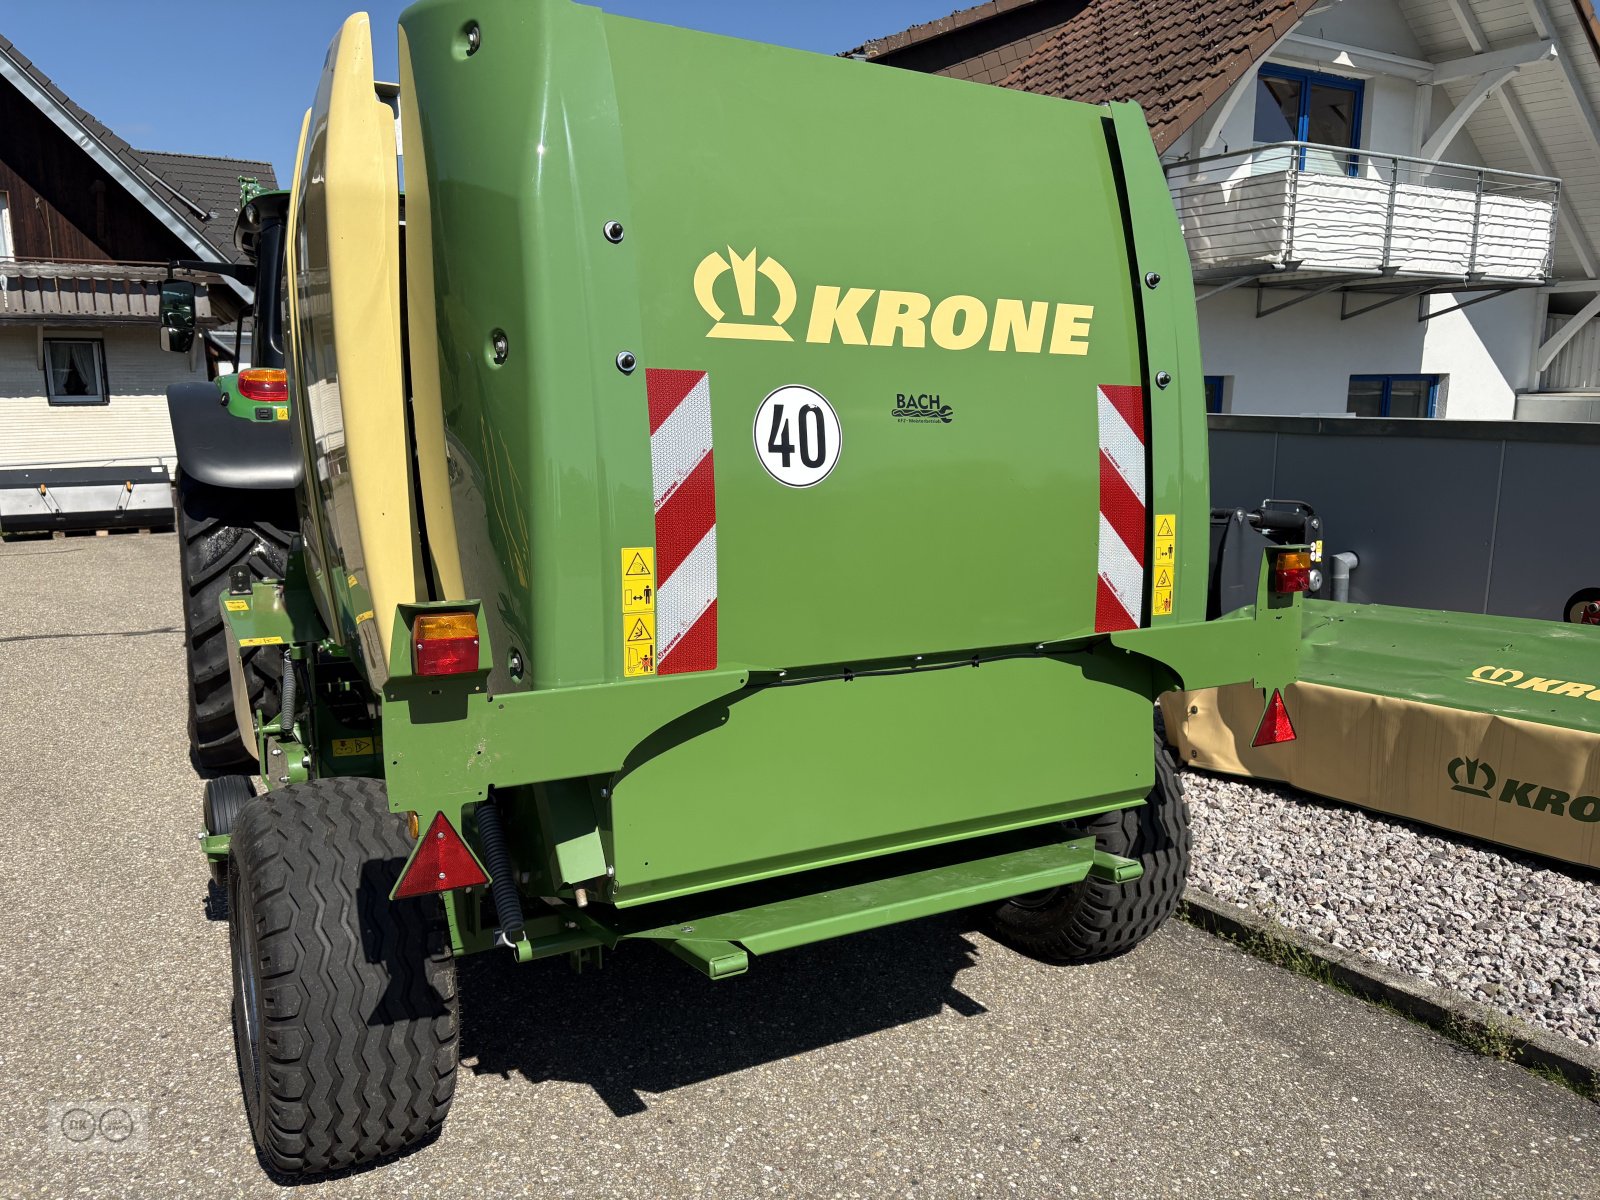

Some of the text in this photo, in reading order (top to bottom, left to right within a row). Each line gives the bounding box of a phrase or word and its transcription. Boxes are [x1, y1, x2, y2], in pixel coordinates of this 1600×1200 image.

[806, 285, 1094, 356] KRONE
[896, 393, 940, 409] BACH
[768, 403, 826, 469] 40
